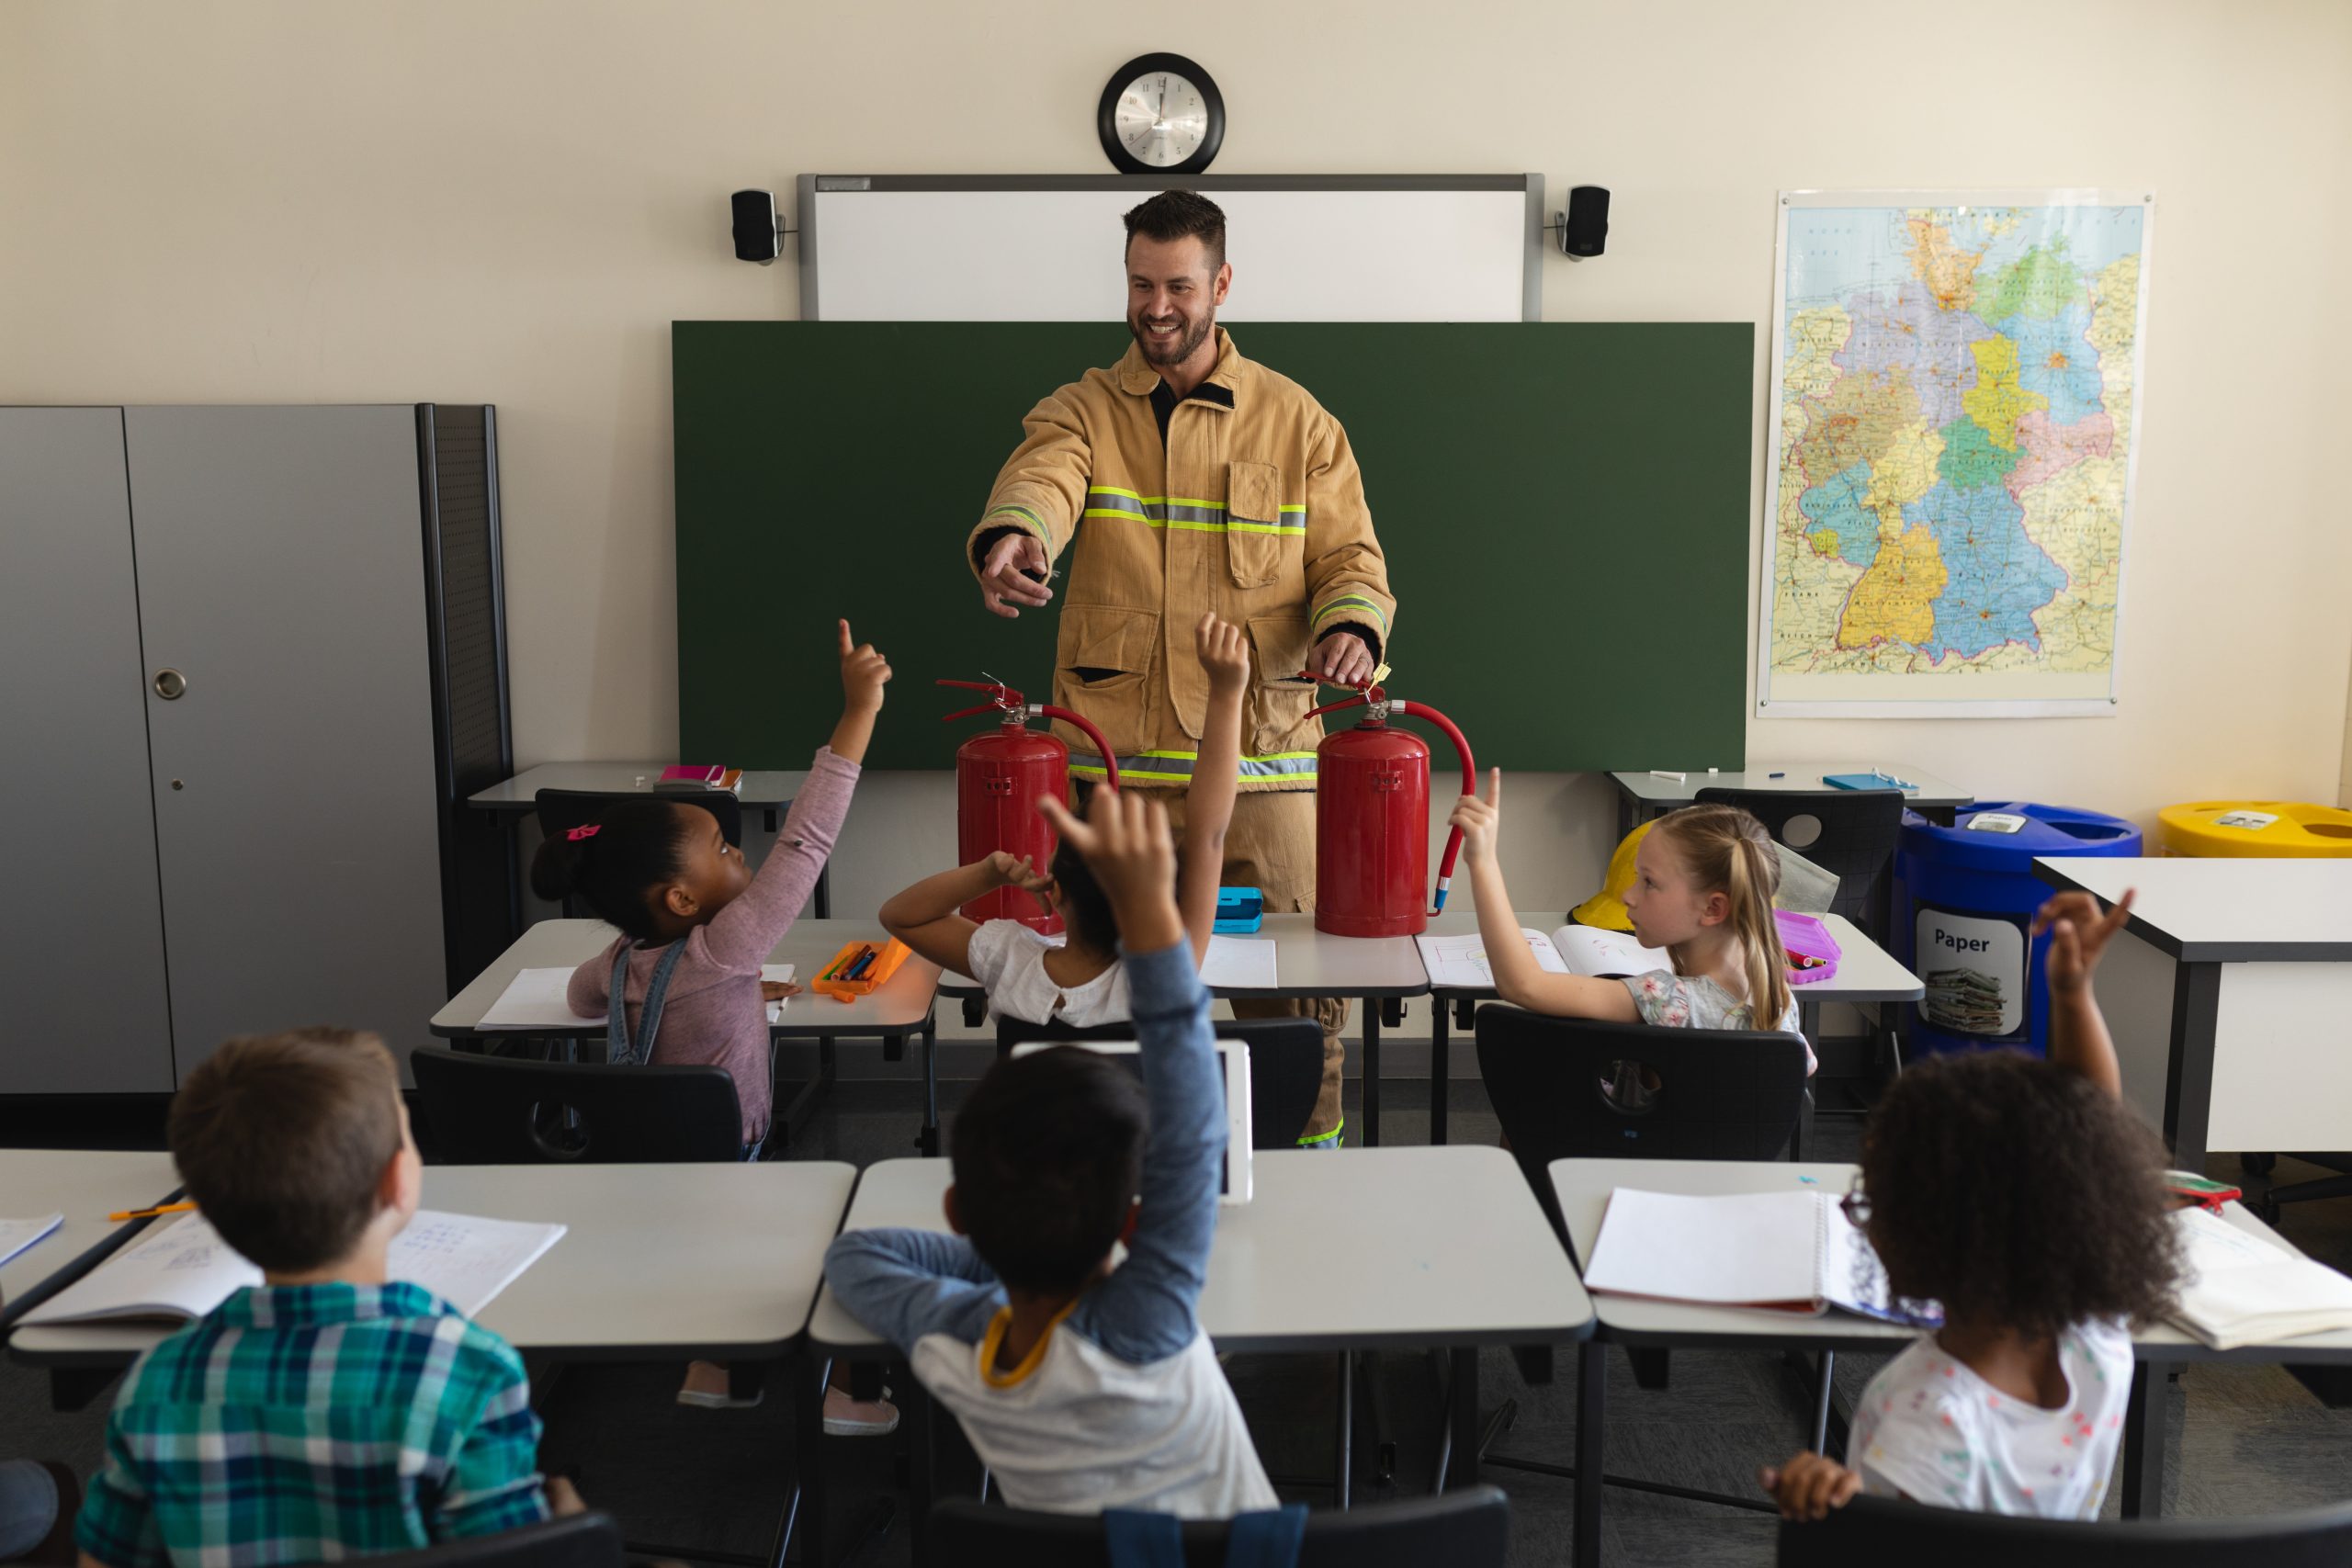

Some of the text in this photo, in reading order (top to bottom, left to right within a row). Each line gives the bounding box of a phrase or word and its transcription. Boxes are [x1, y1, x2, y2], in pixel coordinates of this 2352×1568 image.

[1142, 84, 1149, 93] 11
[1129, 96, 1137, 105] 10
[1188, 97, 1194, 107] 2
[1128, 133, 1134, 141] 8
[1935, 929, 1990, 953] Paper
